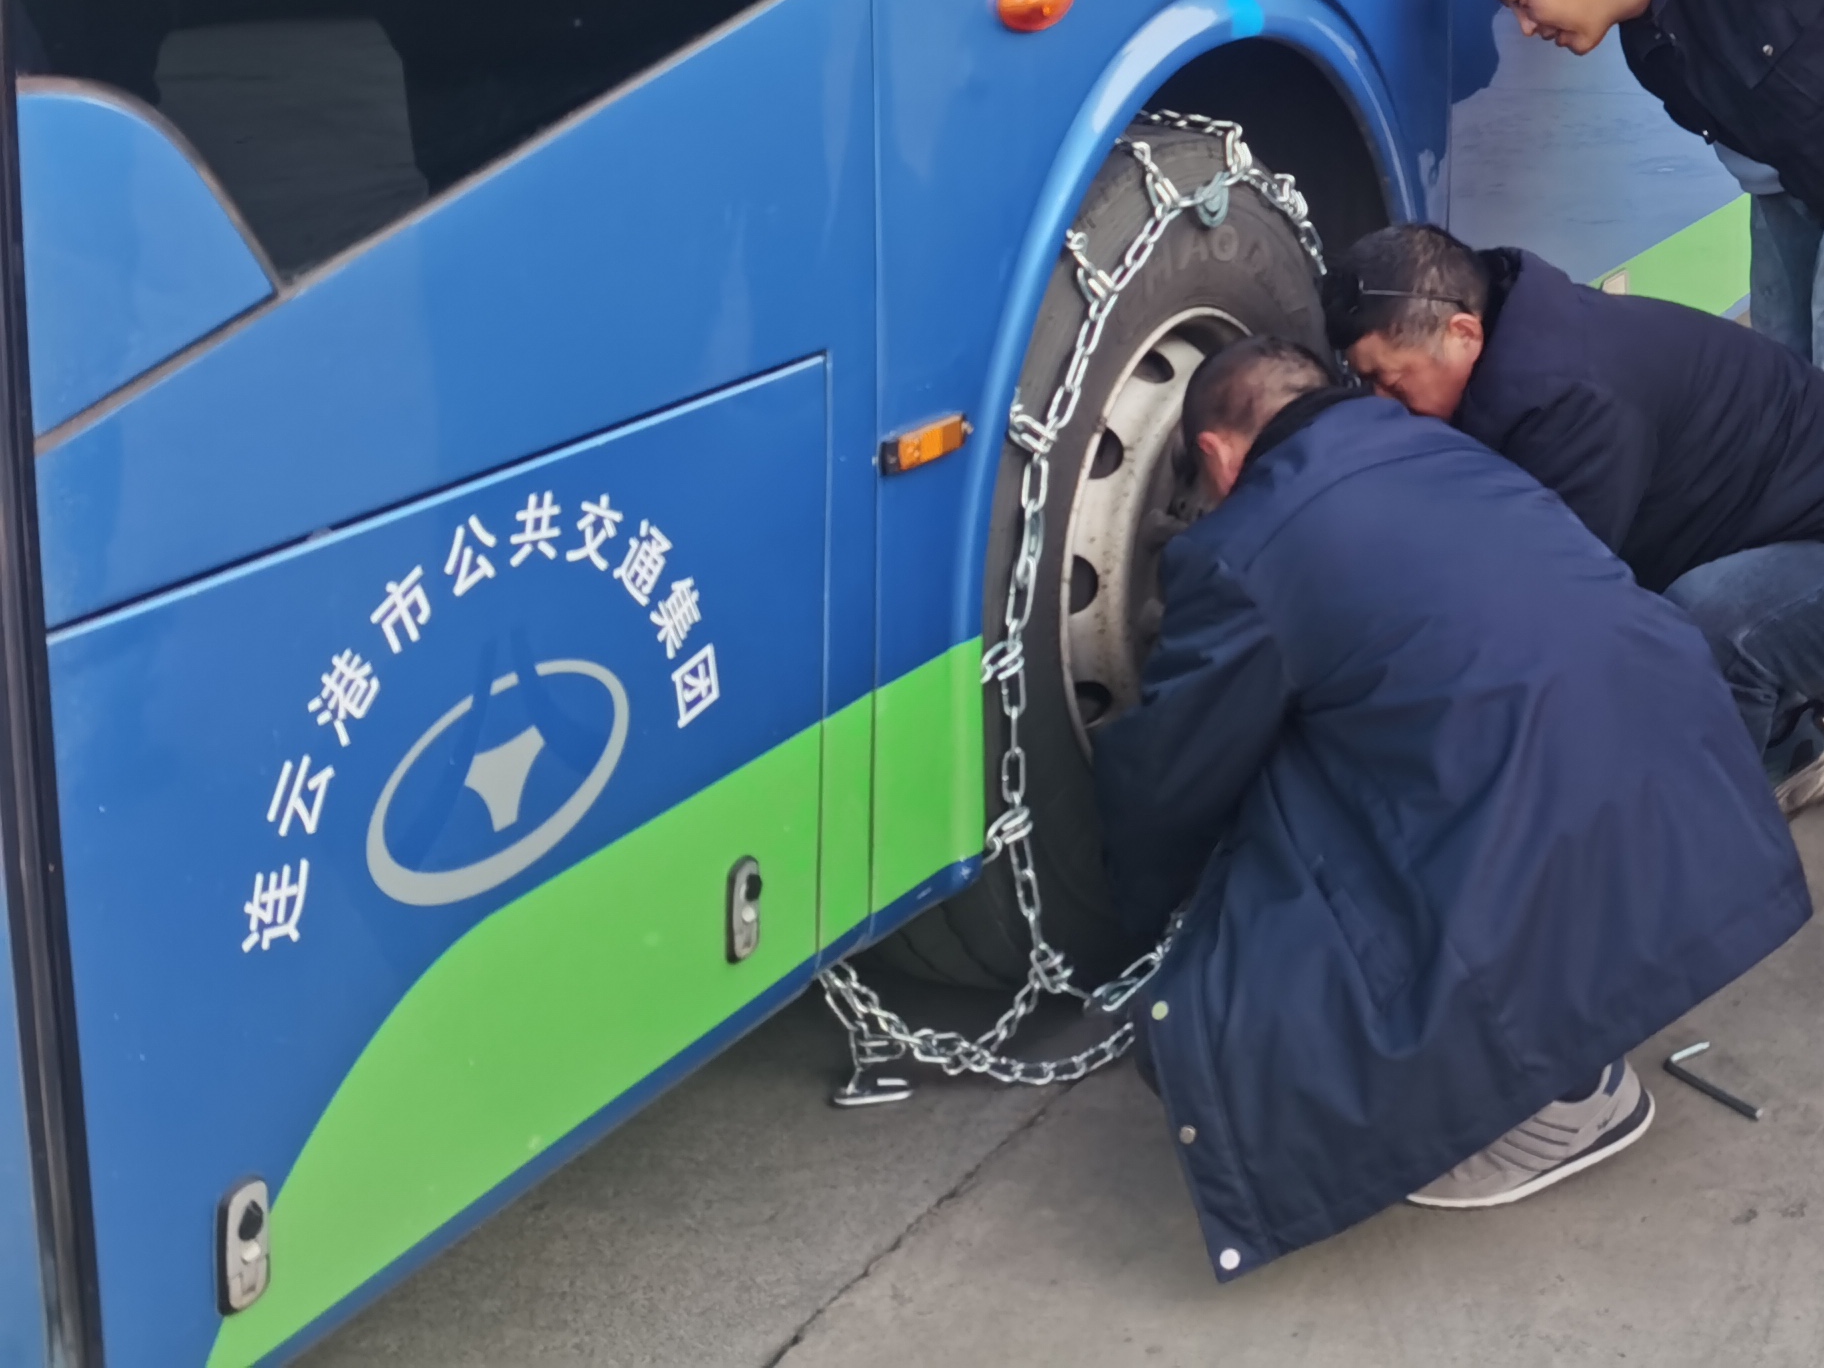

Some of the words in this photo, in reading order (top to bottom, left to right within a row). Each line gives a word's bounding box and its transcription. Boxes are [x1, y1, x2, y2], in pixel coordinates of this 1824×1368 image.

[241, 491, 720, 953] 连云港市公共交通集团
